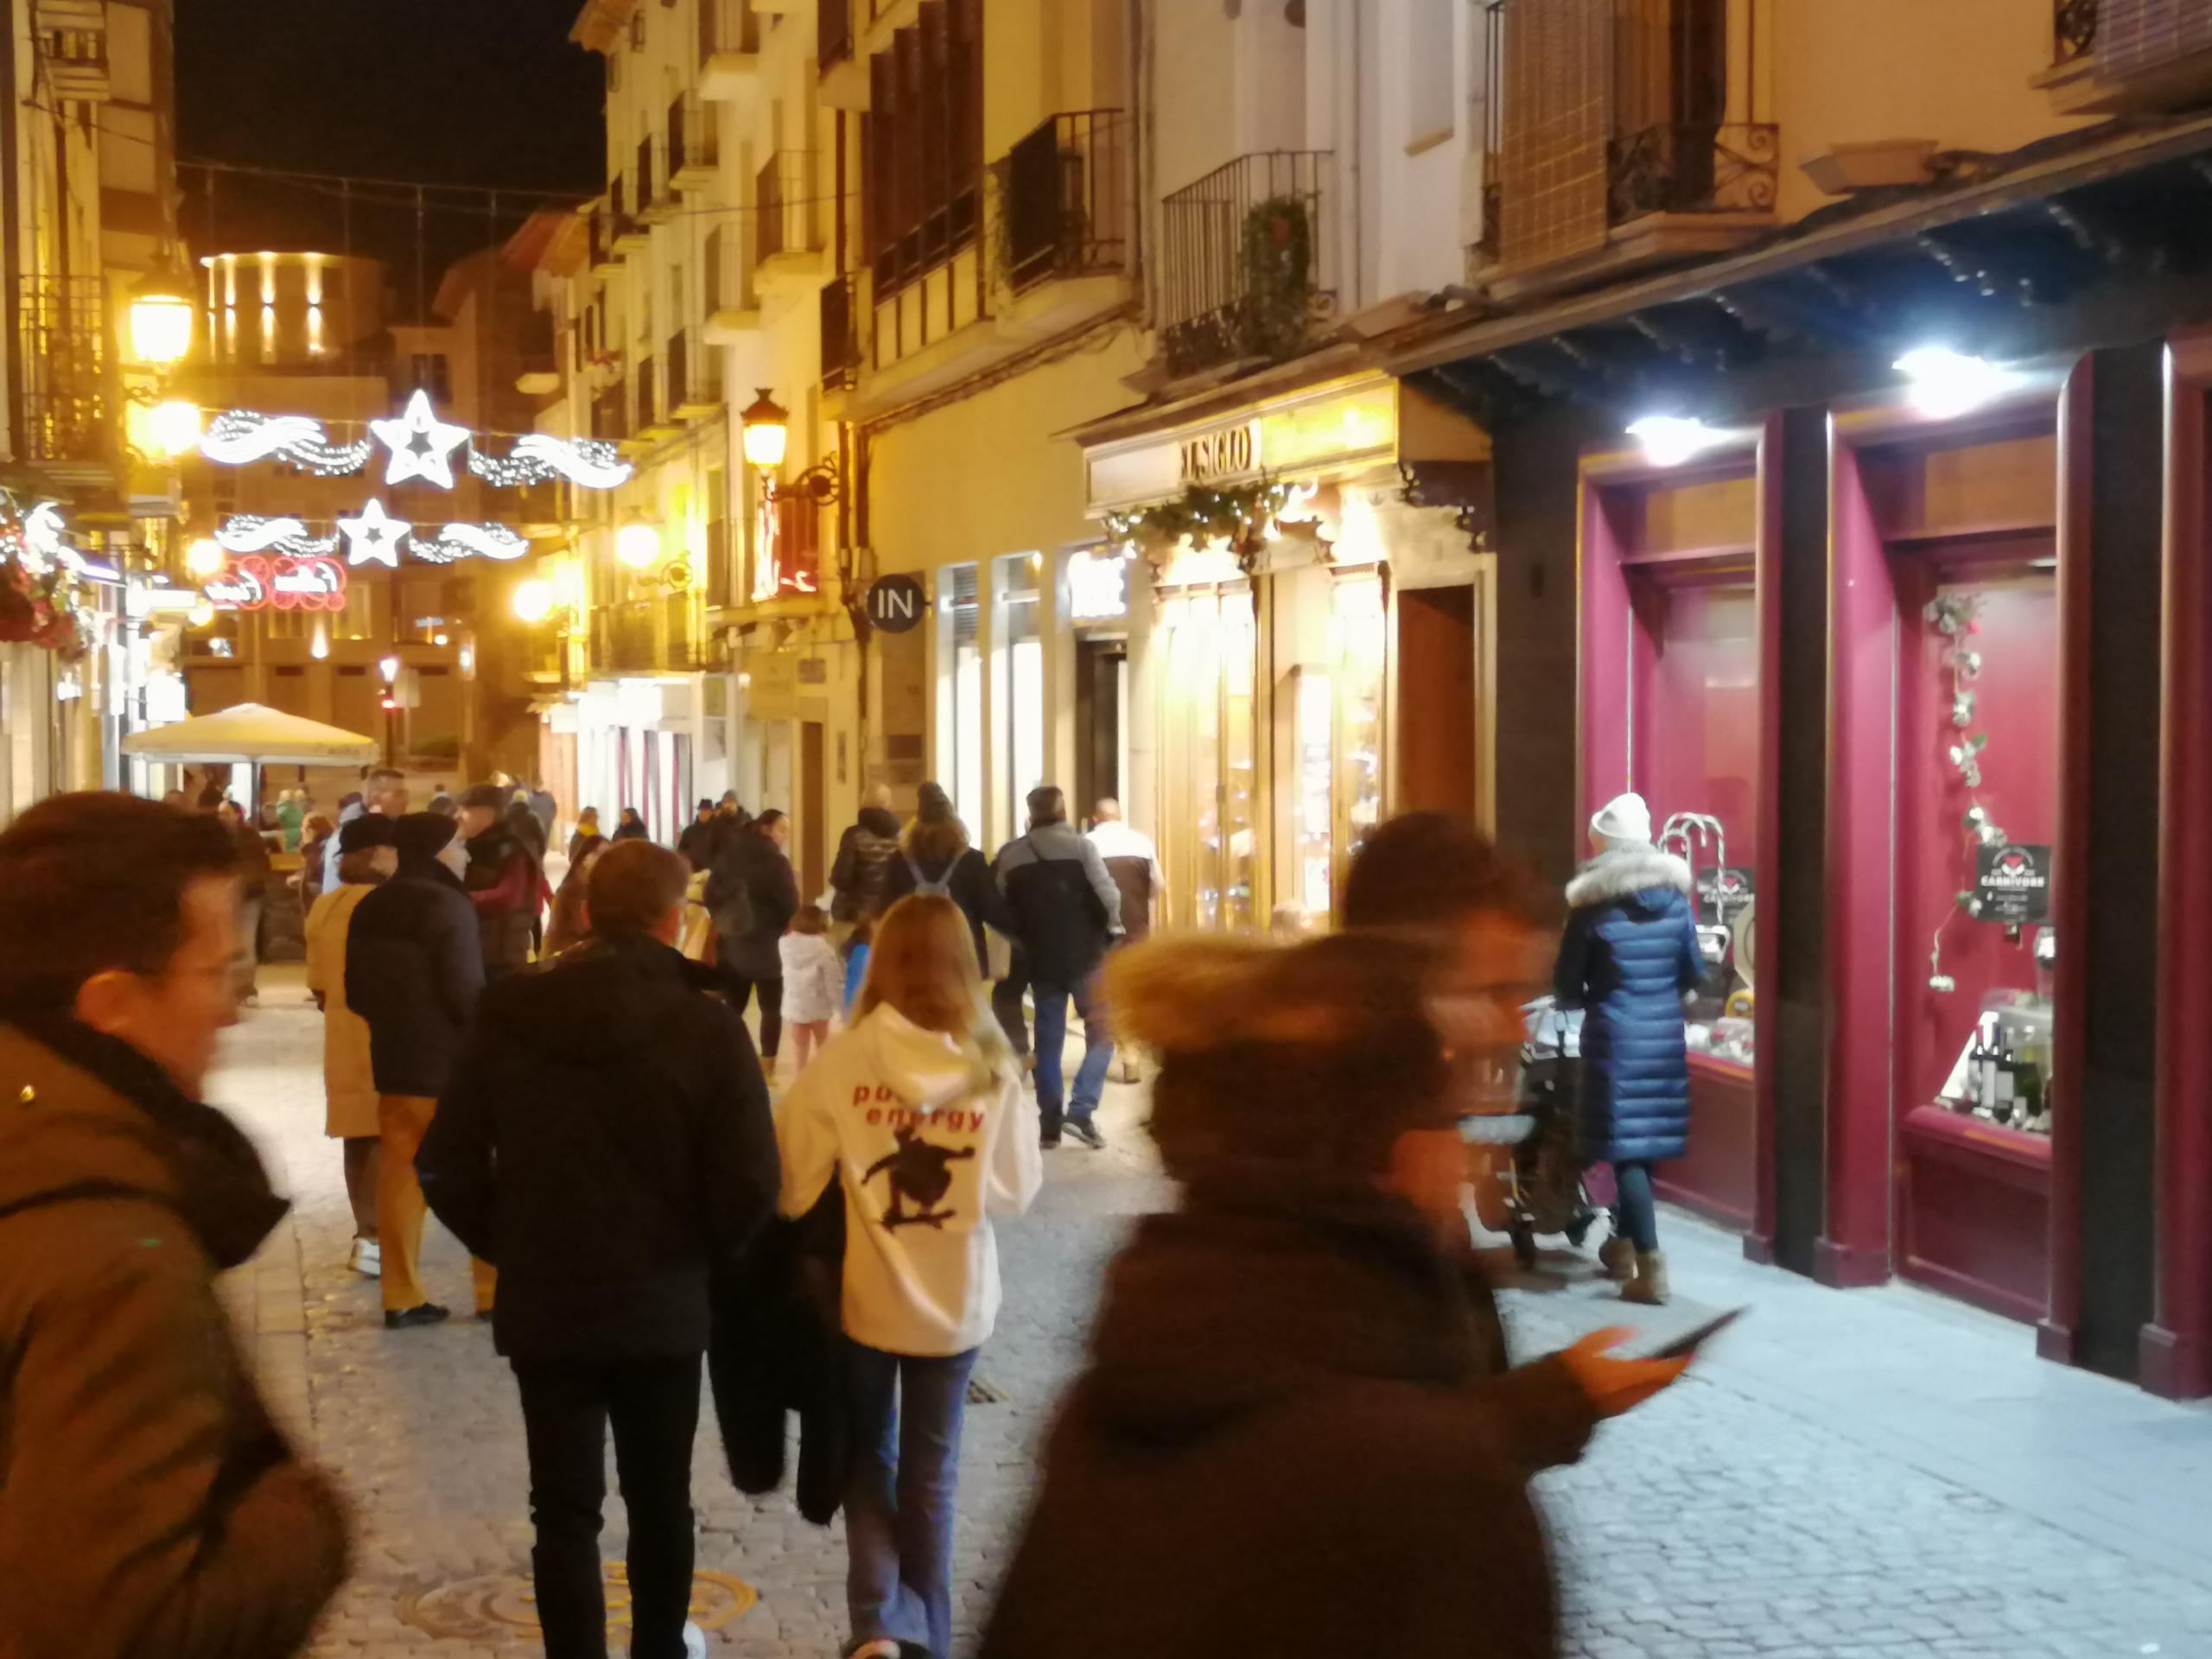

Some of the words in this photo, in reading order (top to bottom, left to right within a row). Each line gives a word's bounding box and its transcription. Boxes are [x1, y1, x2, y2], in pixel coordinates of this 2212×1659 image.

[1198, 425, 1251, 479] SIGLO
[878, 588, 912, 619] IN
[853, 1084, 893, 1107] pu
[865, 1108, 985, 1134] energy
